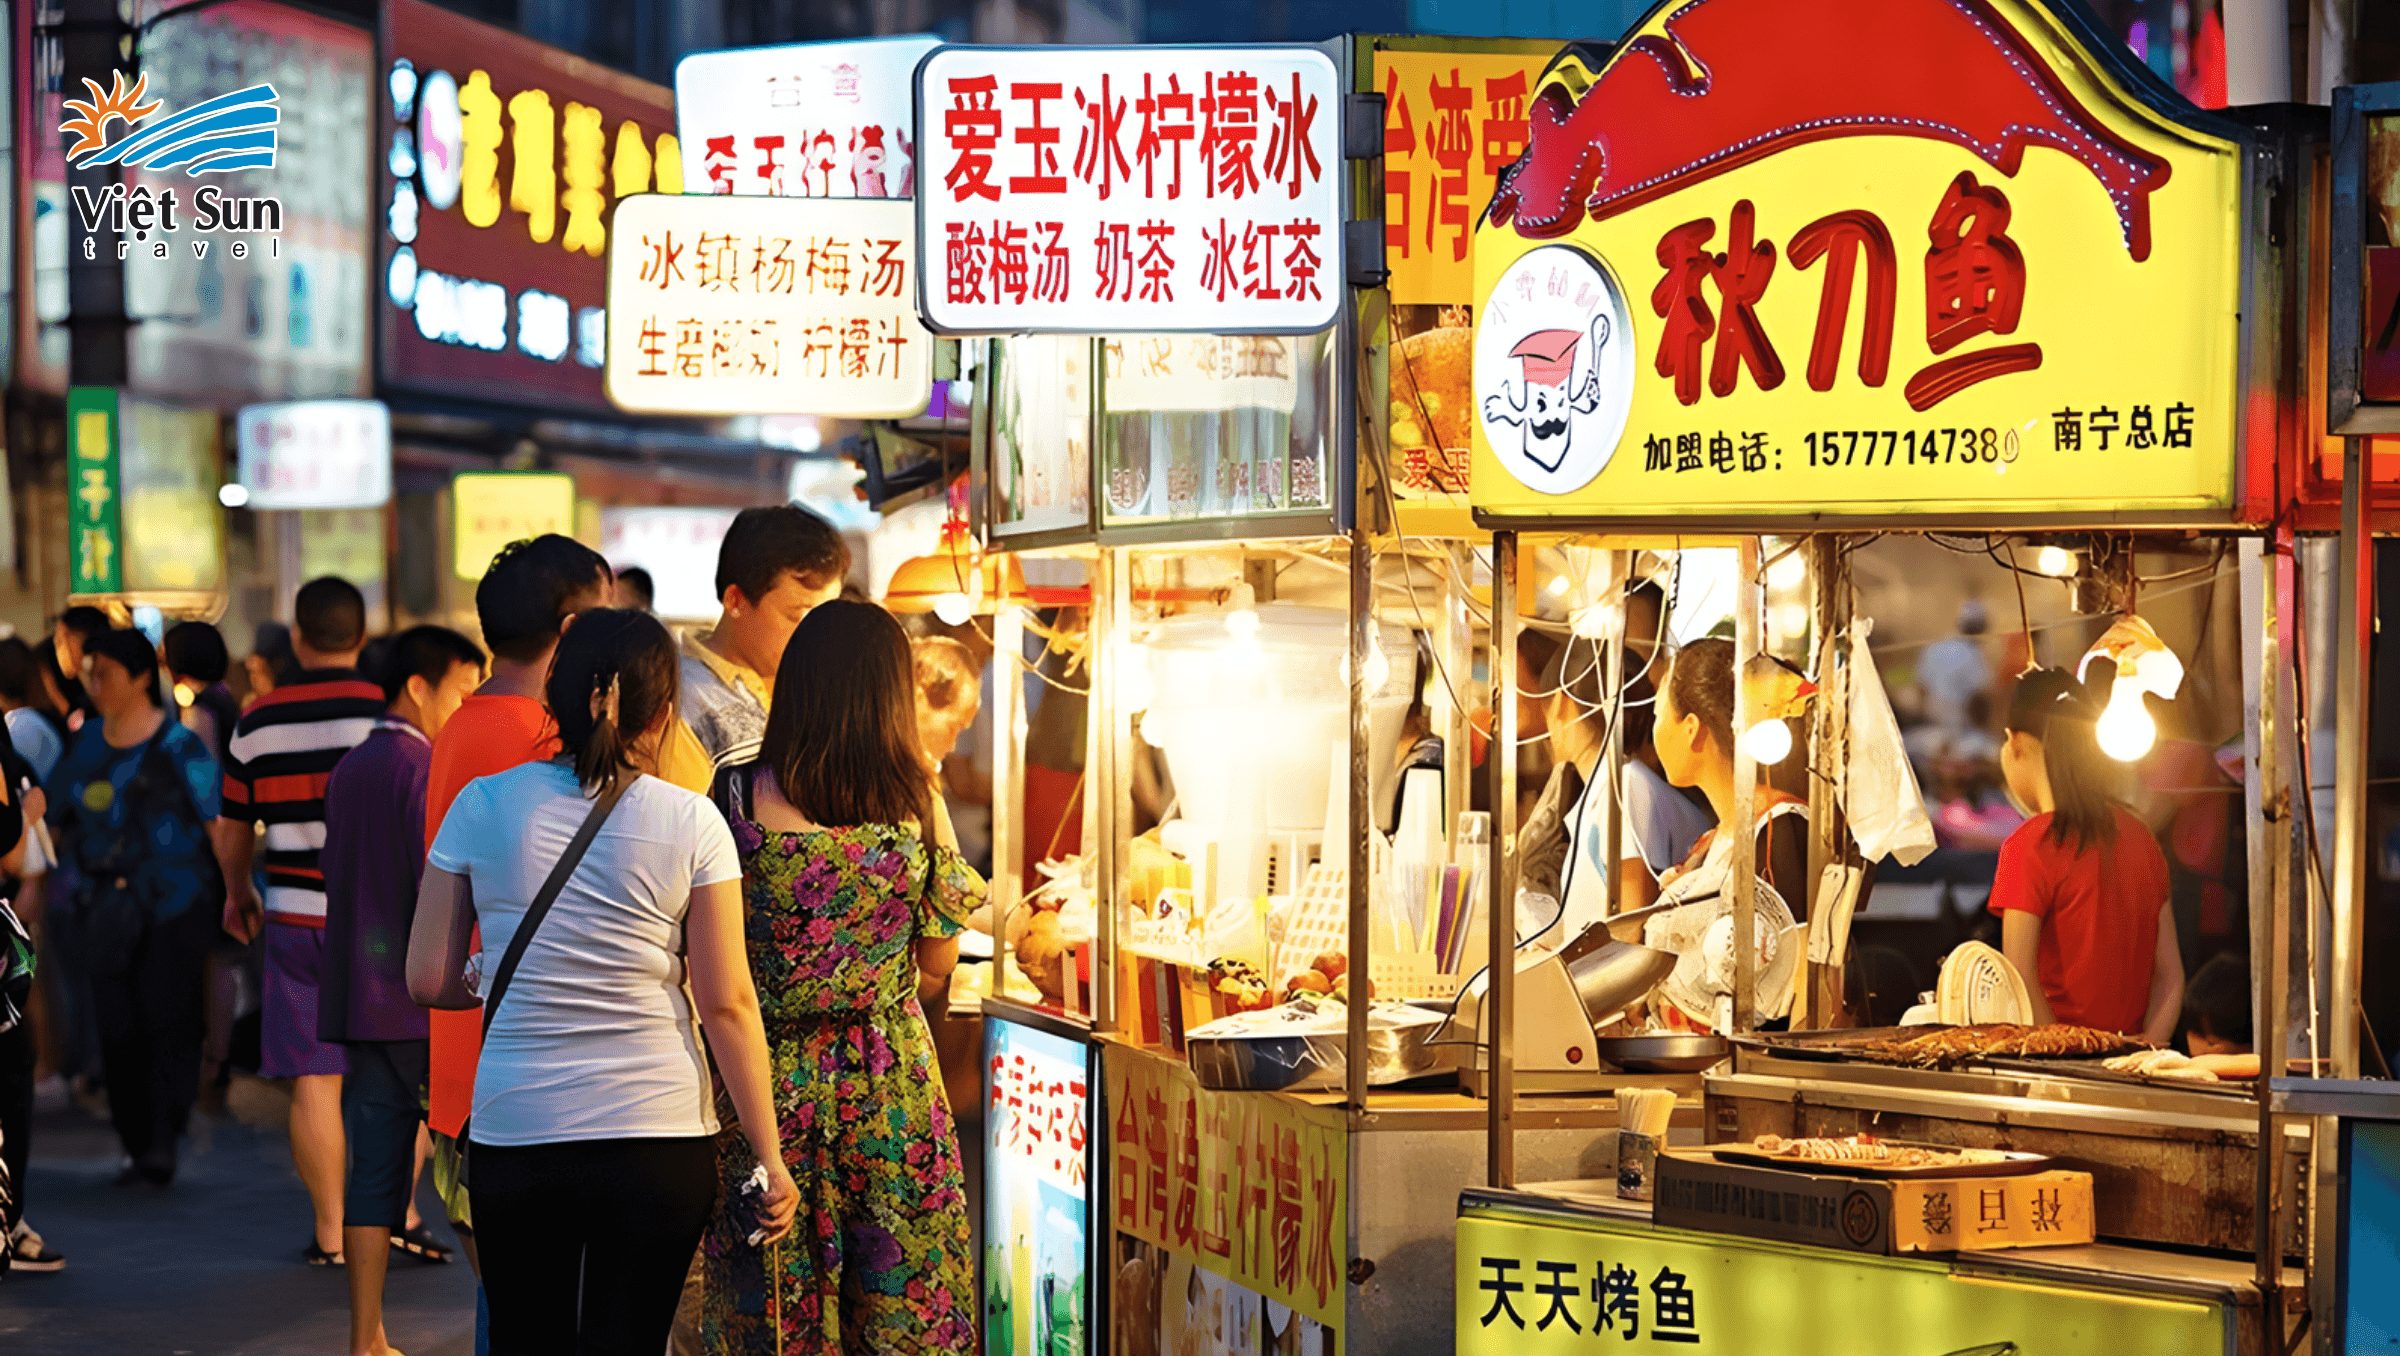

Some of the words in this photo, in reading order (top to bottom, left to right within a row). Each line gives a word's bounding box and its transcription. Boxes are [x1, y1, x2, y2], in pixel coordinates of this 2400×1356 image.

[944, 70, 1322, 202] 爱玉冰柠檬冰
[639, 229, 905, 297] 冰镇杨梅汤
[945, 217, 1069, 304] 酸梅汤
[1094, 219, 1175, 303] 奶茶
[1200, 217, 1322, 303] 冰红茶
[1650, 168, 2043, 412] 秋刀鱼
[802, 315, 908, 379] 柠檬汁
[1643, 429, 1782, 473] 加盟电话：
[2051, 402, 2194, 452] 南宁总店
[1479, 1256, 1702, 1345] 天天烤鱼
